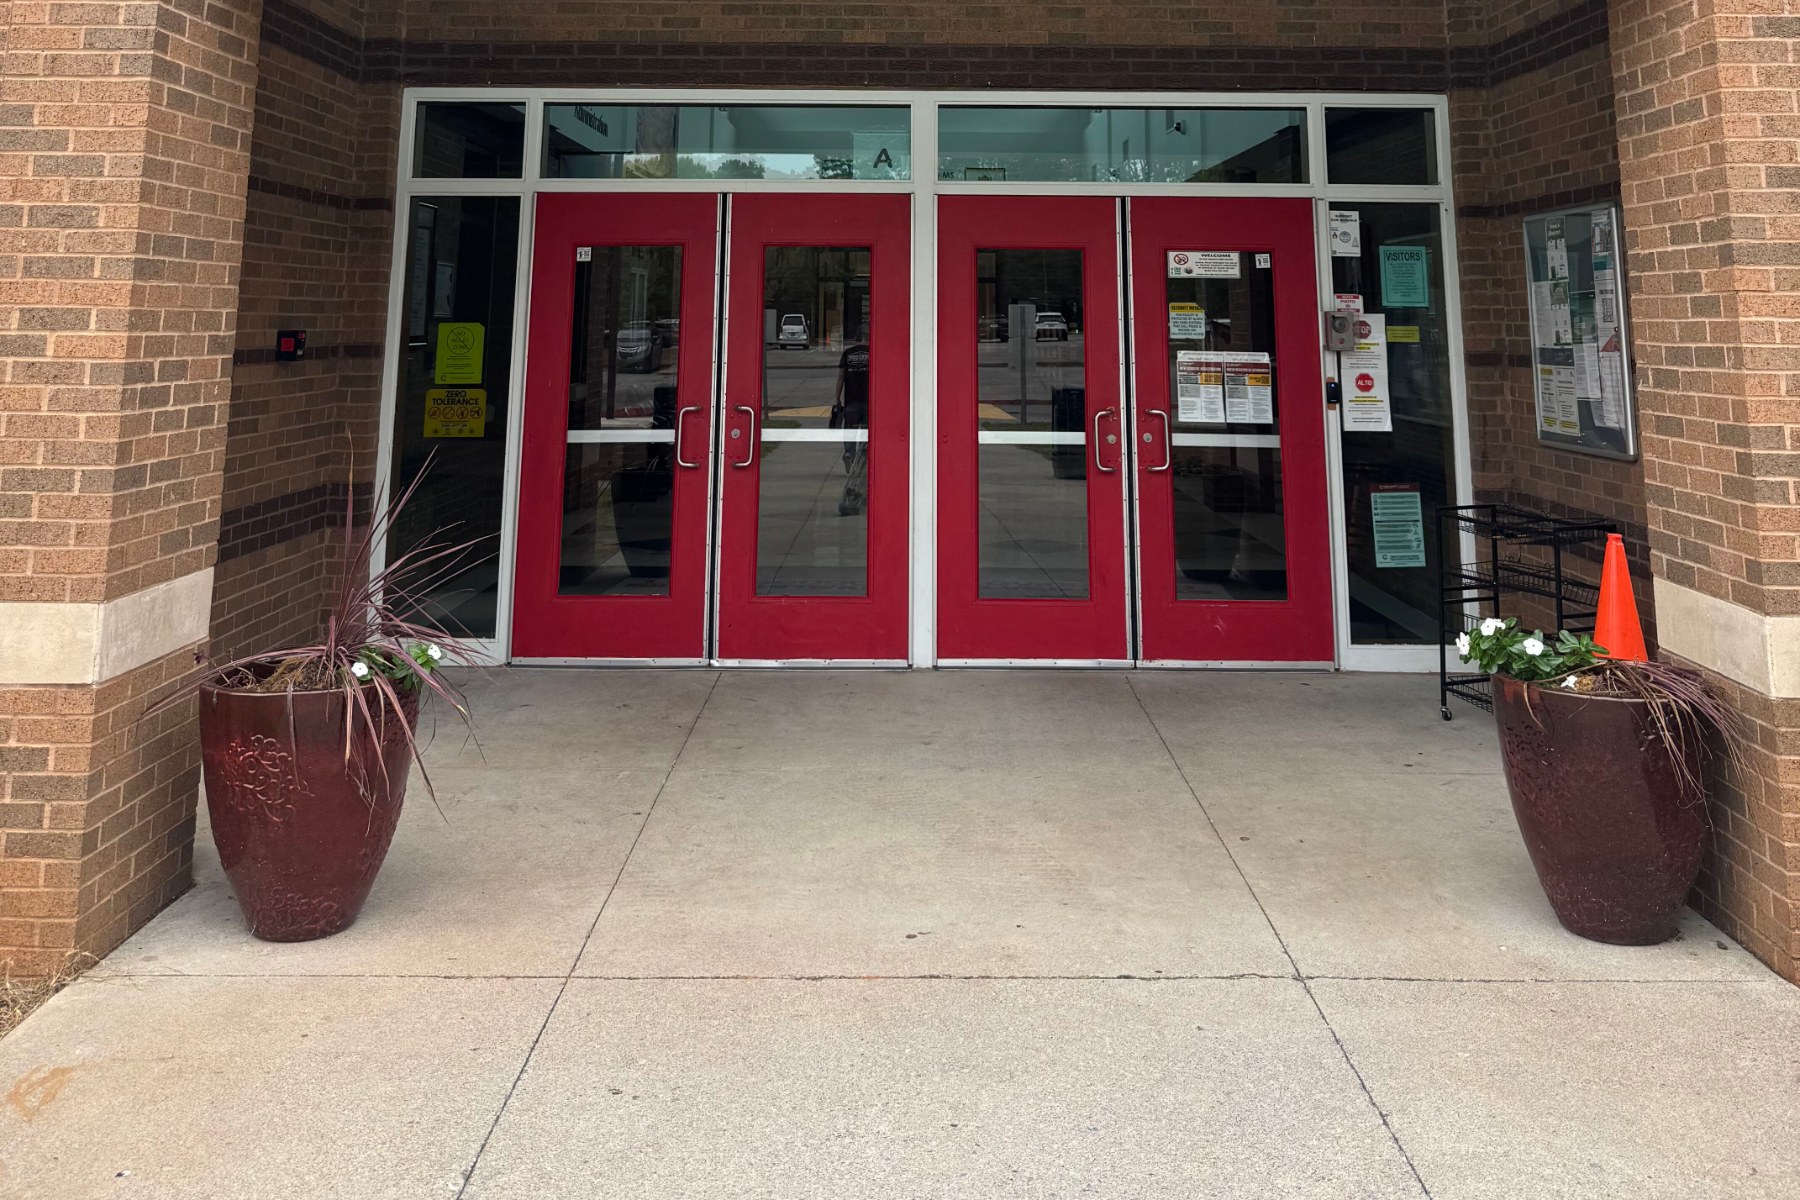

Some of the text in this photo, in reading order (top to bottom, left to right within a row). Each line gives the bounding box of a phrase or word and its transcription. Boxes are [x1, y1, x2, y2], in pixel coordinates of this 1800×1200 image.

[872, 147, 894, 169] A
[1385, 251, 1421, 262] VISITORS
[445, 390, 467, 398] ZERO
[432, 398, 480, 406] TOLERANCE
